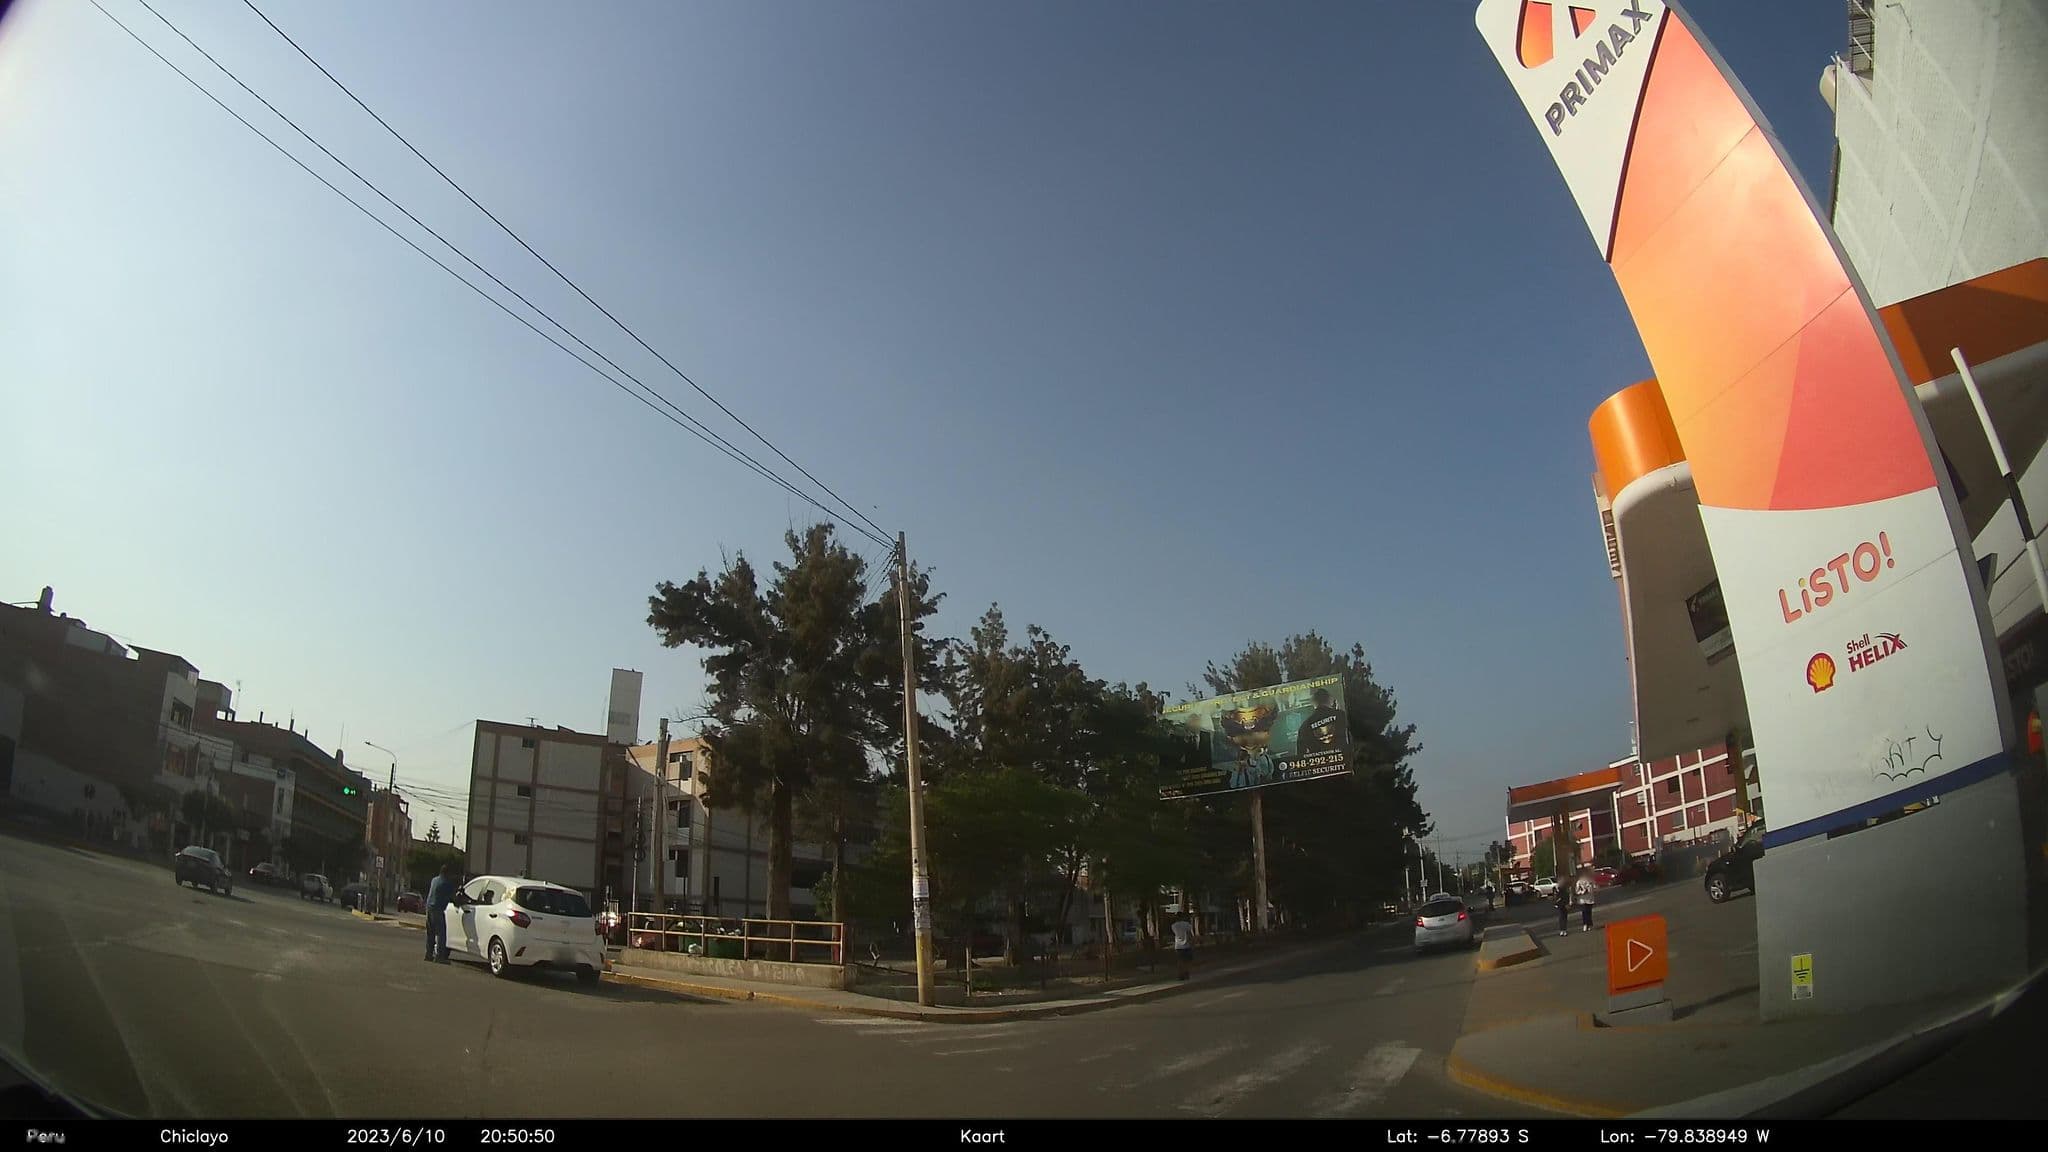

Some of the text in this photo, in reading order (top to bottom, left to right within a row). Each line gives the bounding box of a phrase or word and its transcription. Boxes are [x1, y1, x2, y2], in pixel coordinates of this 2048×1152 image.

[1544, 0, 1653, 136] PRIMAX
[1846, 634, 1871, 654] Shell
[1848, 632, 1908, 672] HELIX
[1261, 677, 1339, 697] GUARDIANSHIP
[1311, 715, 1337, 729] SECURITY
[1289, 754, 1344, 770] 948-292-215
[1312, 763, 1346, 775] SECURITY
